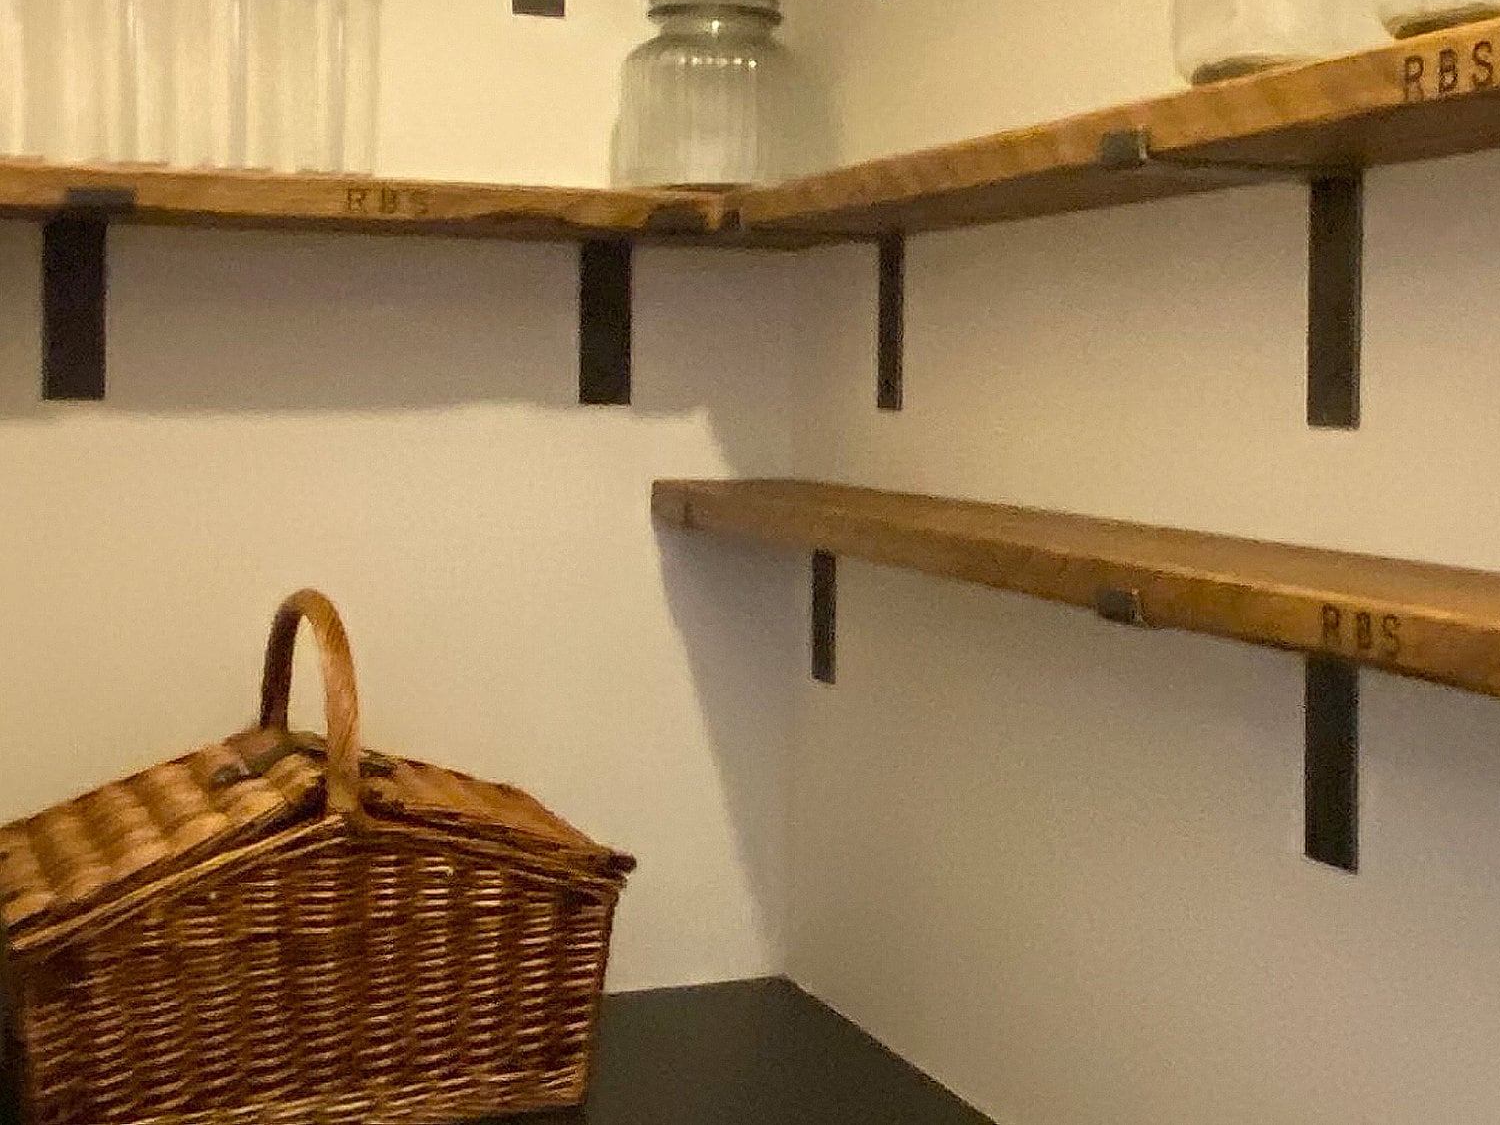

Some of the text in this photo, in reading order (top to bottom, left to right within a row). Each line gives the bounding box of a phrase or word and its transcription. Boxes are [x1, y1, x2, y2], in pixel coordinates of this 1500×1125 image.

[1402, 40, 1494, 102] RBS
[346, 186, 431, 215] RBS
[1321, 603, 1402, 659] RBS
